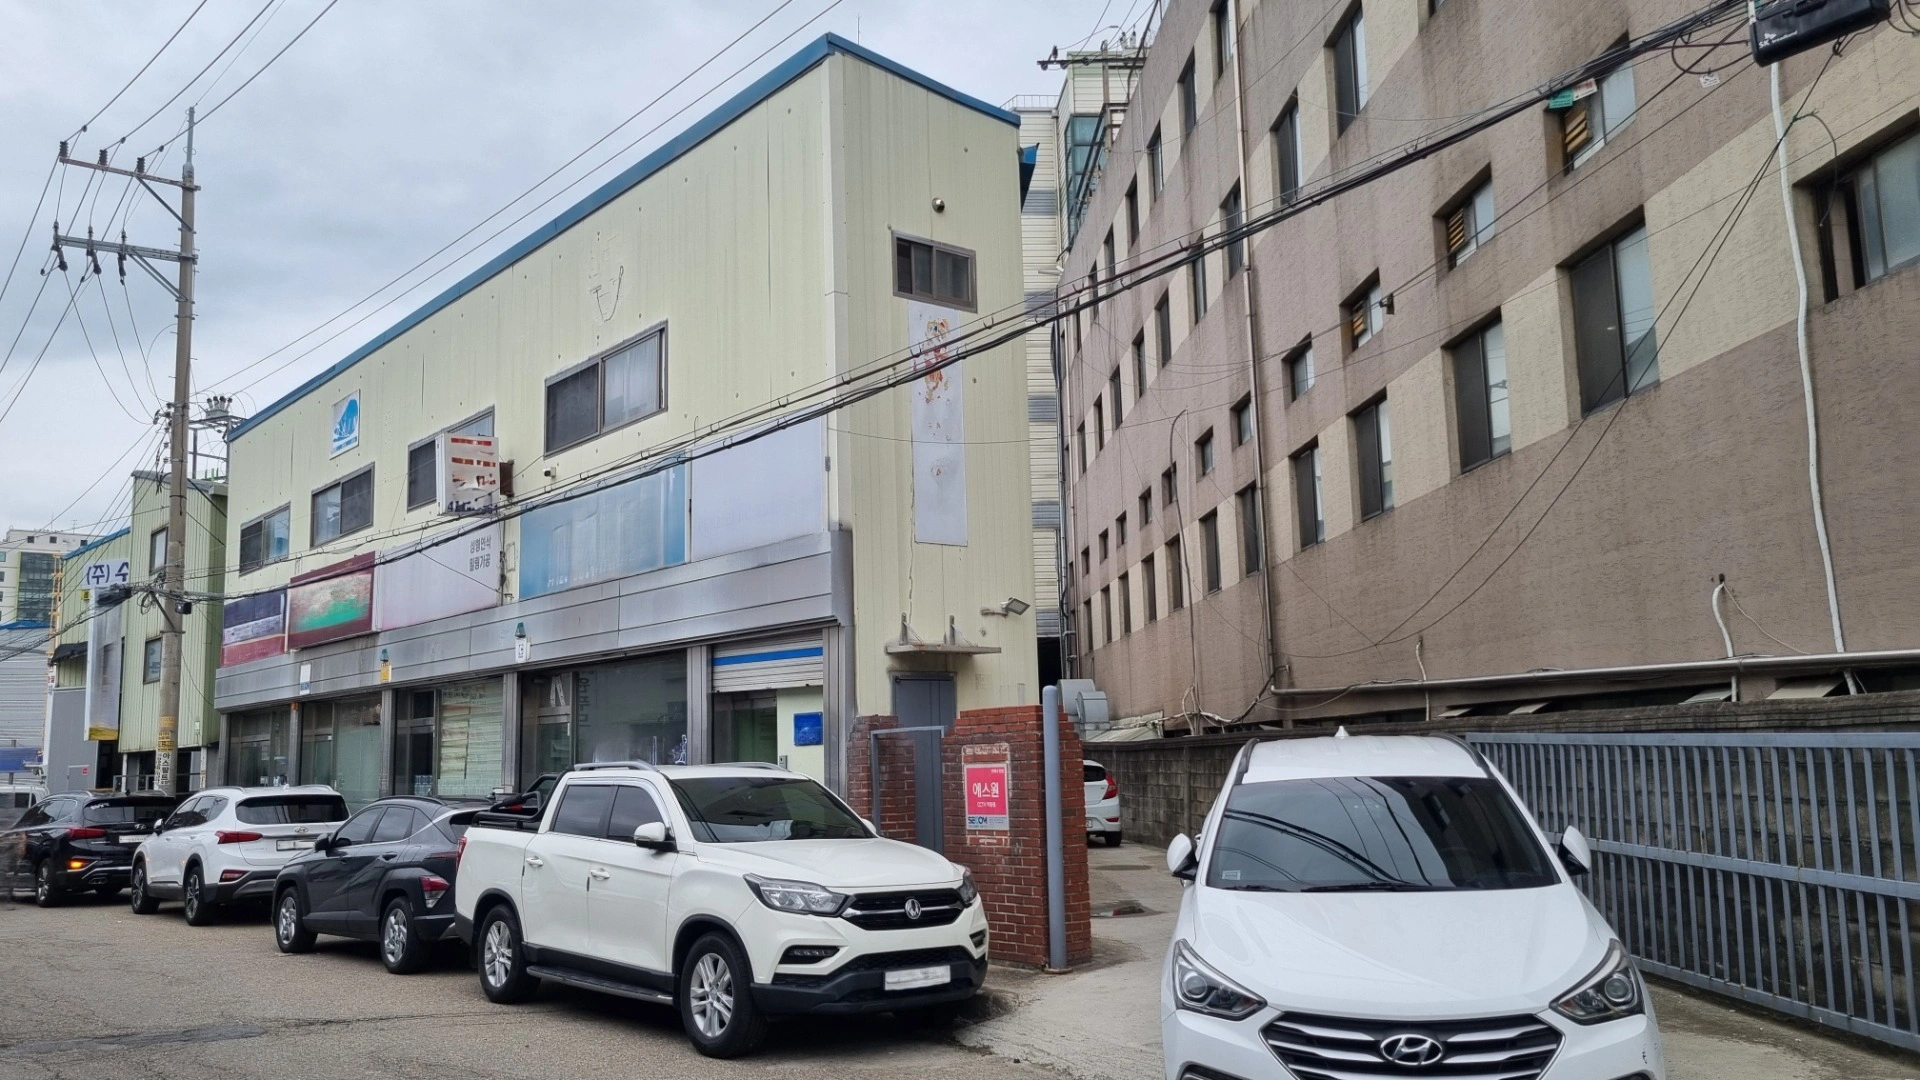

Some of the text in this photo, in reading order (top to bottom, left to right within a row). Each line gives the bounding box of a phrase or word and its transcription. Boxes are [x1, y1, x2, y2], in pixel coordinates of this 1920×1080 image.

[1759, 39, 1770, 49] SK
[470, 535, 492, 554] 성형연삭
[87, 564, 110, 585] (주)
[972, 781, 999, 798] 에스원
